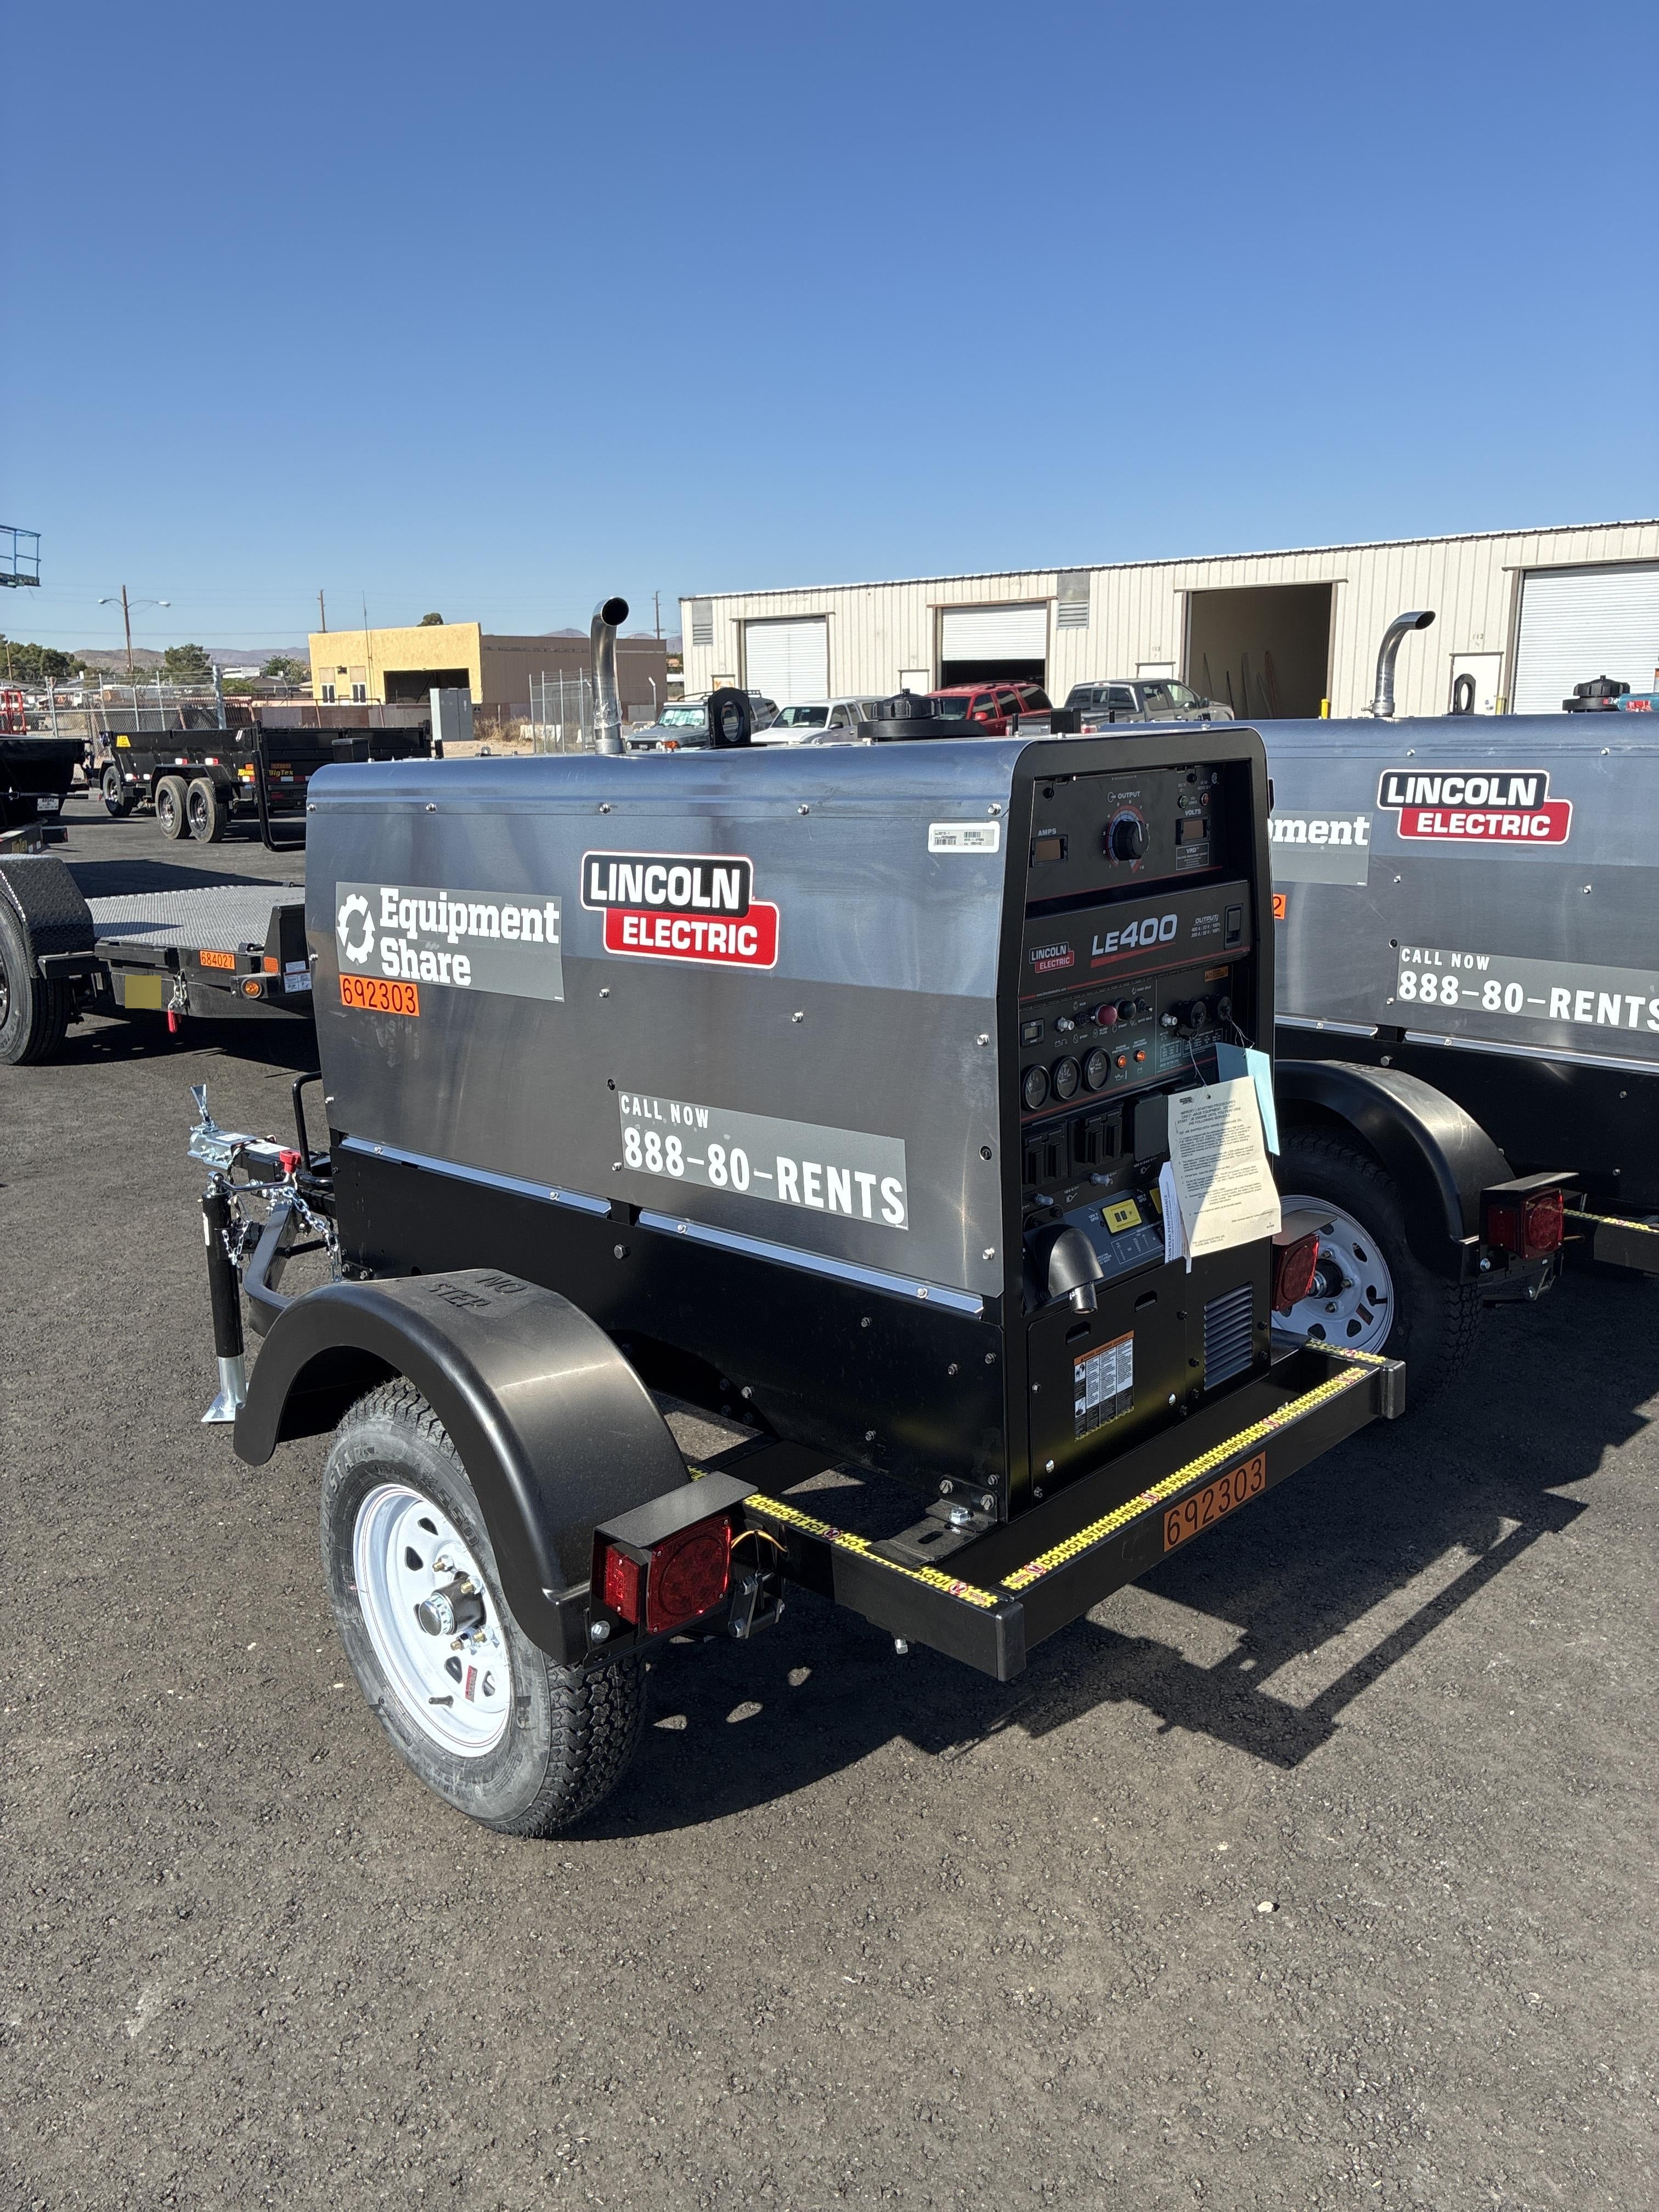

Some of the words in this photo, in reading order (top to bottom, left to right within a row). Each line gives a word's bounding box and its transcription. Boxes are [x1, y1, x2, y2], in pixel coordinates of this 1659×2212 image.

[1118, 791, 1141, 799] OUTPUT
[1387, 777, 1537, 806] LINCOLN
[1038, 828, 1057, 836] AMPS
[1417, 812, 1551, 837] ELECTRIC
[590, 862, 740, 910] LINCOLN
[380, 888, 560, 944] Equipment
[623, 916, 758, 956] ELECTRIC
[1091, 914, 1178, 956] LE400
[201, 952, 233, 968] 684027
[380, 936, 471, 986] Share
[1031, 945, 1066, 961] LINCOLN
[1040, 957, 1070, 970] ELECTRIC
[1401, 948, 1443, 966] CALL
[1451, 953, 1490, 971] NOW
[342, 978, 416, 1014] 692303
[1399, 970, 1659, 1032] 888-80-RENTS
[621, 1095, 663, 1120] CALL
[670, 1104, 709, 1128] NOW
[623, 1127, 905, 1224] 888-80-RENTS
[428, 1284, 492, 1307] STEP
[474, 1275, 528, 1294] NO
[1274, 1412, 1290, 1421] NO
[1288, 1404, 1302, 1413] SE
[1300, 1392, 1324, 1407] PARE
[1154, 1483, 1172, 1494] NE
[1172, 1472, 1191, 1486] PAS
[1189, 1455, 1220, 1474] TENEZ
[1216, 1434, 1256, 1456] DEBOUT
[1251, 1426, 1268, 1435] ICI
[756, 1500, 806, 1523] DEBOUT
[805, 1521, 823, 1532] ICI
[1167, 1458, 1262, 1546] 692303
[839, 1536, 860, 1547] NO
[1040, 1554, 1060, 1566] DO
[1059, 1539, 1081, 1555] NOT
[1082, 1517, 1120, 1539] STAND
[1117, 1500, 1148, 1517] HERE
